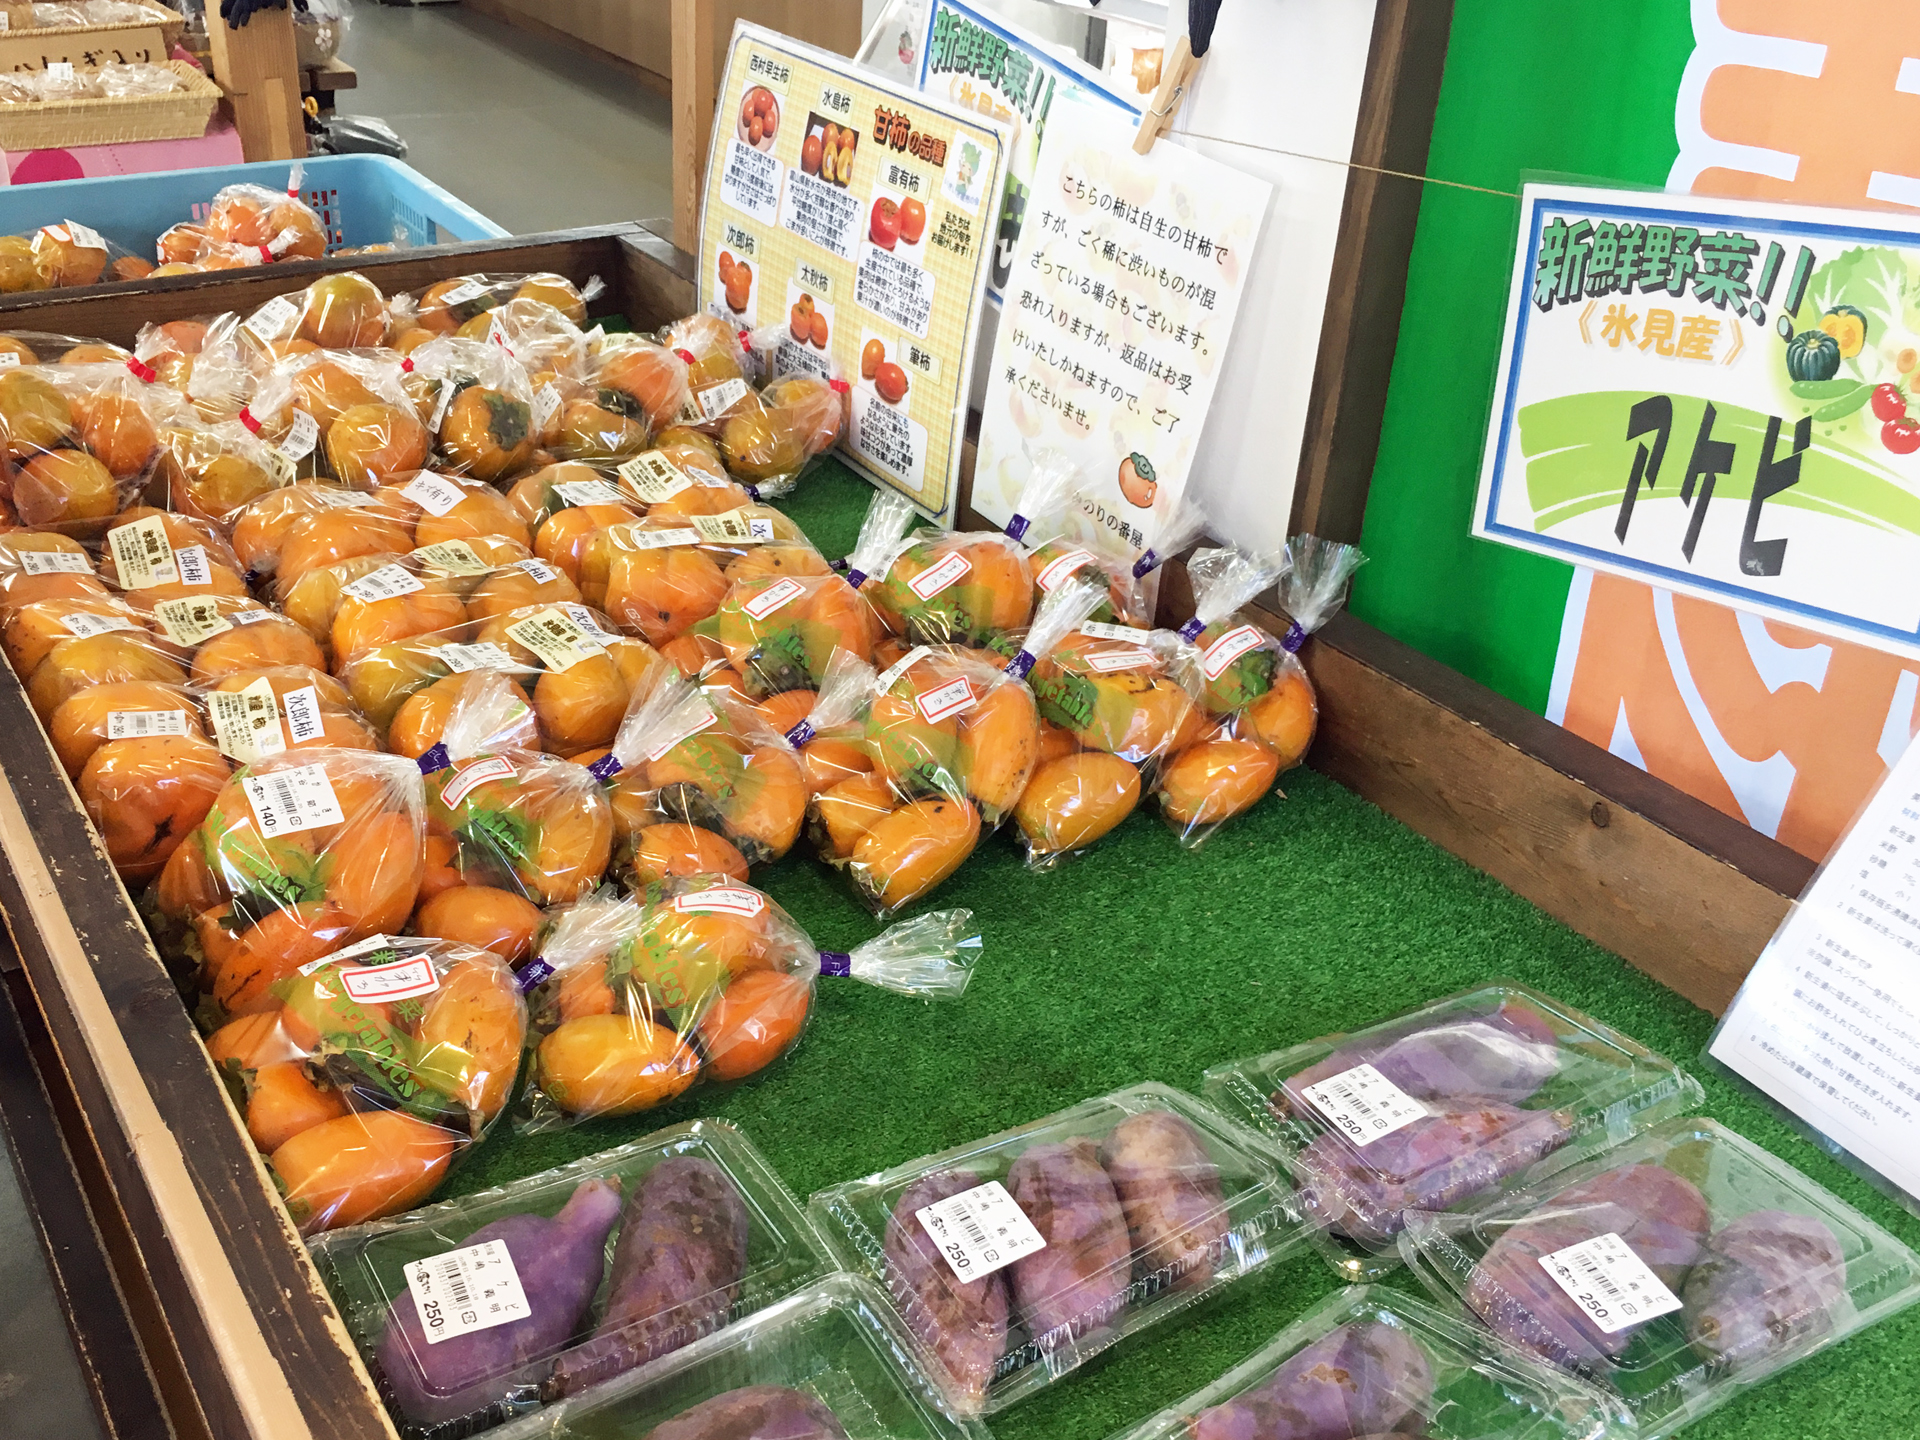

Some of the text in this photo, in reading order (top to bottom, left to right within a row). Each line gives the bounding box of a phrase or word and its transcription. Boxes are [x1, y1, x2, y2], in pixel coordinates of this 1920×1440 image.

[750, 54, 790, 84] 西村早生柿
[930, 6, 1056, 138] 新鮮野菜!!
[822, 88, 851, 115] 水島柿
[872, 104, 947, 168] 甘柿の品種
[888, 165, 921, 193] 富有柿
[939, 223, 971, 246] 地元の旬を
[945, 211, 970, 231] 私たちは
[1062, 174, 1229, 266] こちらの柿は自生の甘柿で
[726, 225, 755, 255] 次郎柿
[801, 265, 829, 293] 太秋柿
[1041, 210, 1216, 310] すが、ごく稀に渋いものが混
[1533, 217, 1817, 343] 新鮮野菜!!
[1030, 251, 1209, 356] ざっている場合もございます。
[909, 346, 931, 372] 筆柿
[1020, 289, 1193, 396] 恐れ入りますが、返品はお受
[1004, 365, 1090, 431] 承くださいませ。
[1012, 328, 1181, 433] けいたしかねますので、ご了
[870, 398, 909, 428] 名前の由来にも
[860, 415, 913, 456] ような形をしています。
[860, 439, 909, 477] な甘さを楽しめます。
[414, 479, 453, 507] キズ有り
[1614, 394, 1812, 577] アケビ
[142, 529, 160, 554] 氷見産
[179, 547, 203, 582] 次郎柿
[542, 619, 567, 638] 氷見産
[288, 693, 315, 737] 次郎柿
[1369, 1078, 1416, 1115] アケビ
[991, 1197, 1034, 1246] アケビ
[488, 1258, 519, 1311] アケビ
[1615, 1252, 1669, 1304] アケビ
